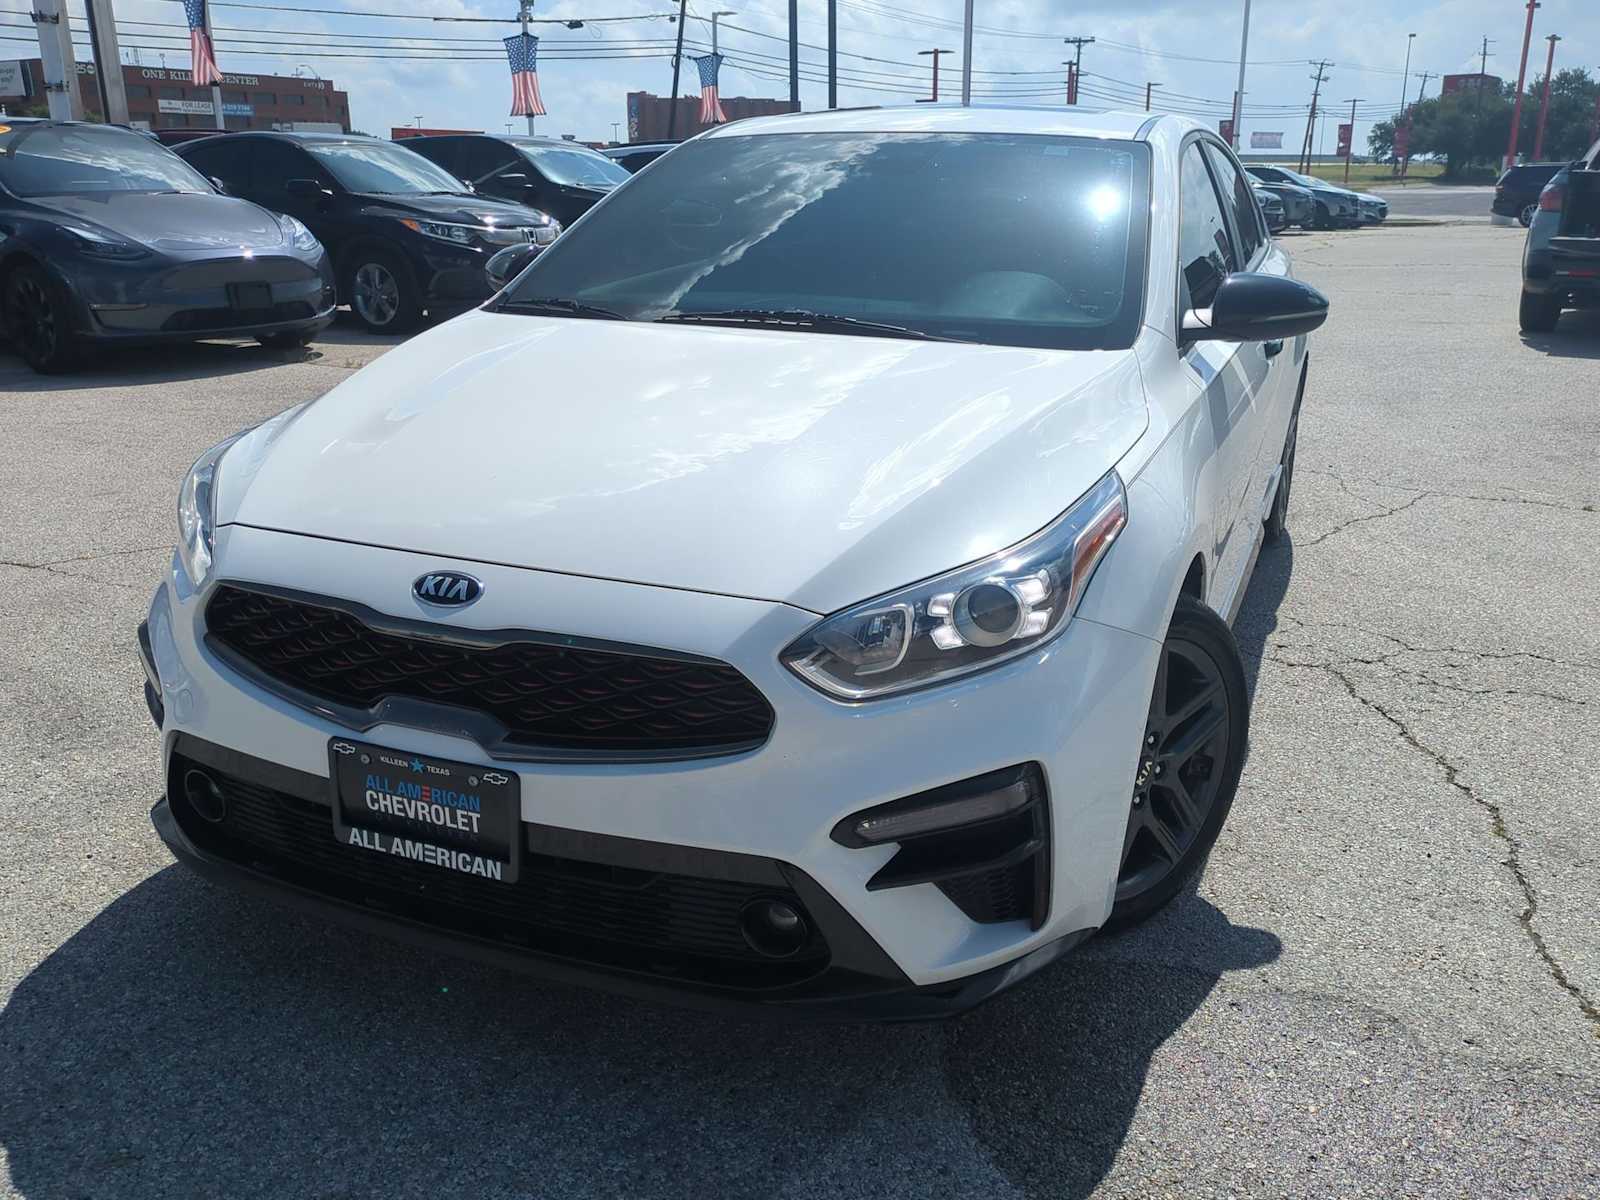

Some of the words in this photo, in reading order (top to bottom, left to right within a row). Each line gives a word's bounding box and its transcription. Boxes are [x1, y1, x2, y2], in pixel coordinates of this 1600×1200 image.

[142, 69, 166, 79] ONE
[420, 575, 469, 601] KIA
[380, 756, 409, 768] KILLEEN
[426, 765, 451, 776] TEXAS
[366, 774, 394, 792] ALL
[397, 782, 481, 811] AMERICAN
[365, 790, 481, 833] CHEVROLET
[349, 827, 386, 853] ALL
[391, 837, 502, 881] AMERICAN
